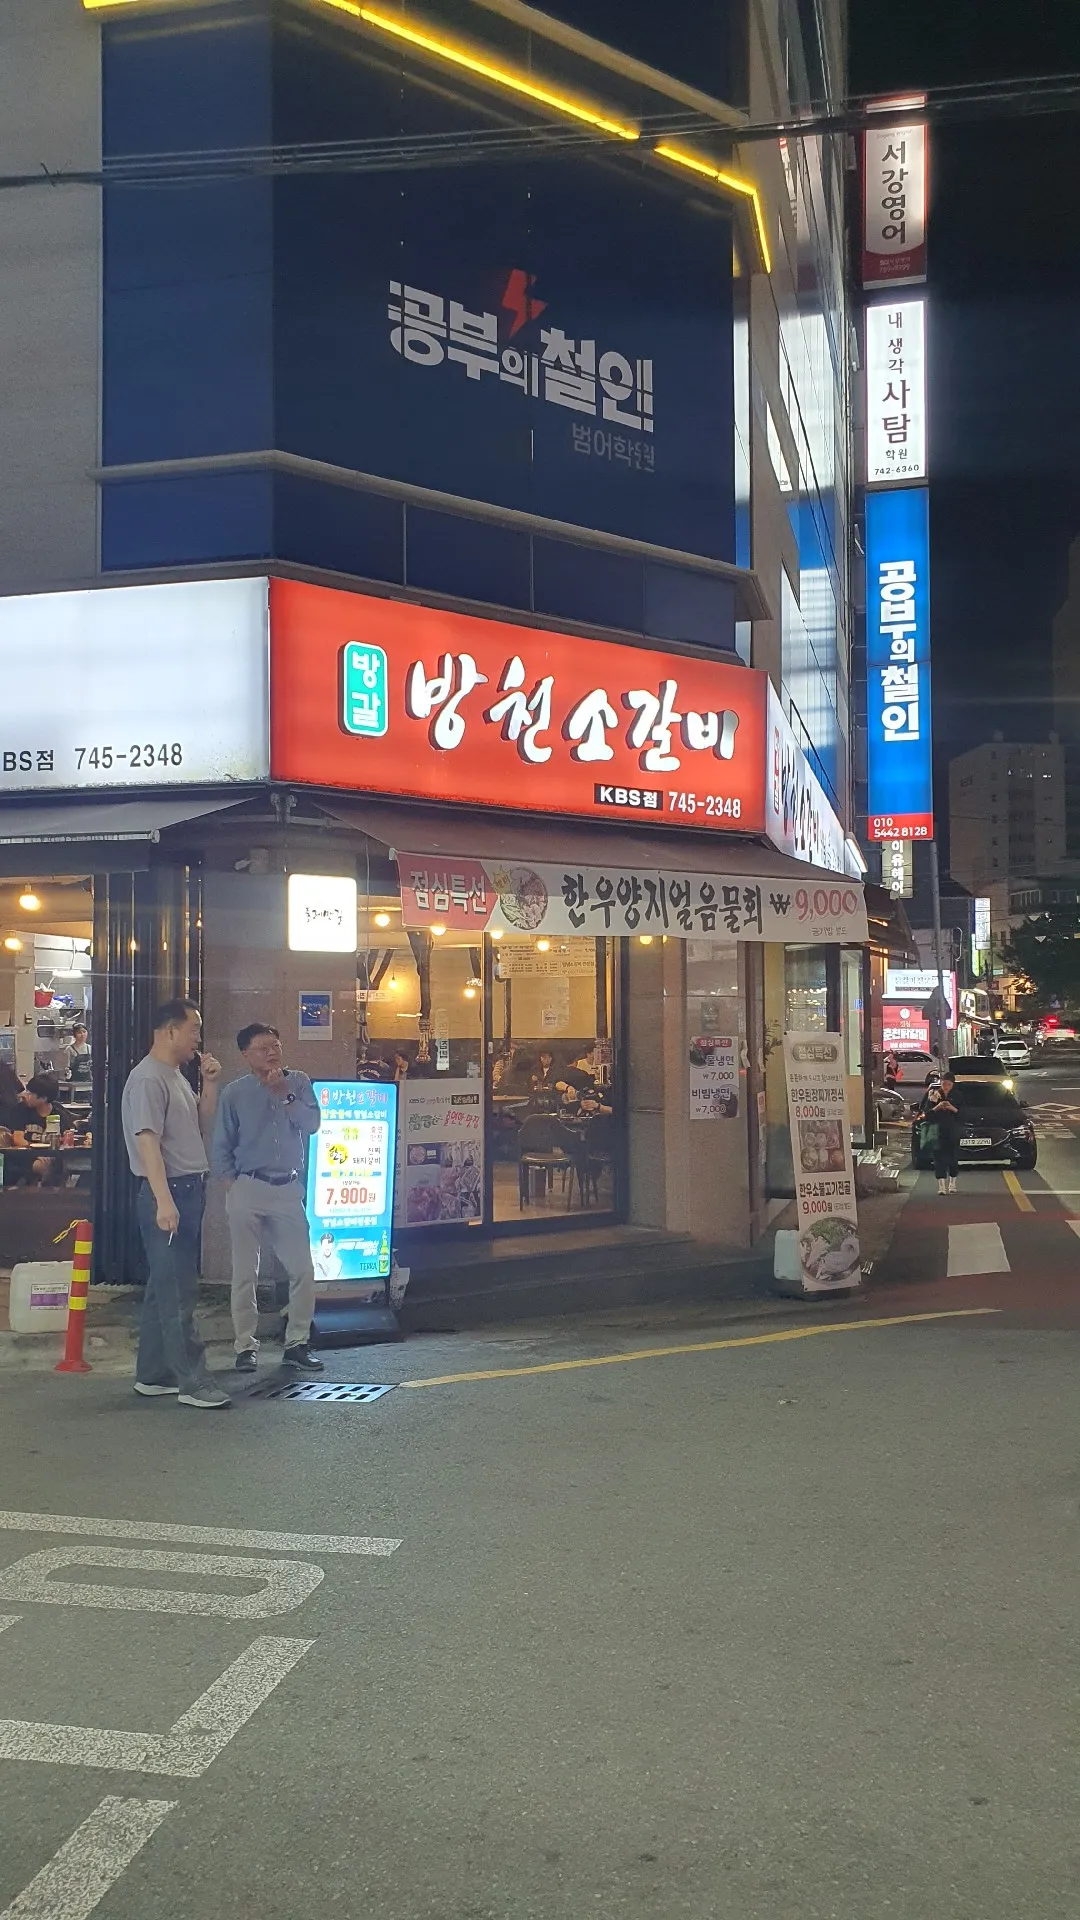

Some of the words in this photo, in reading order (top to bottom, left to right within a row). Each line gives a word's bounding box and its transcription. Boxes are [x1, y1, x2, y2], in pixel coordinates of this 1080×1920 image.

[881, 140, 908, 244] 서강영어
[888, 312, 903, 328] 내
[572, 422, 656, 472] 범어학원
[885, 448, 908, 460] 학원
[874, 464, 920, 476] 742-6360
[351, 652, 381, 728] 방갈
[407, 652, 739, 773] 방천소갈비
[74, 743, 183, 771] 745-2348
[600, 786, 659, 810] KBS점
[668, 790, 741, 819] 745-2348
[873, 818, 894, 827] 010
[874, 828, 900, 838] 5442
[901, 826, 928, 837] 8128
[410, 869, 488, 914] 점심특선
[561, 873, 763, 936] 한우양지얼음물회
[811, 926, 833, 937] 공기밥
[798, 1045, 833, 1060] 점심특선
[707, 1055, 735, 1067] 물냉면
[691, 1087, 731, 1101] 비빔냉면
[790, 1088, 845, 1103] 한우된장찌개정식
[795, 1105, 826, 1118] 8,000원
[326, 1187, 376, 1205] 7,900원
[799, 1180, 851, 1198] 한우소불고기전골
[802, 1200, 832, 1215] 9,000원
